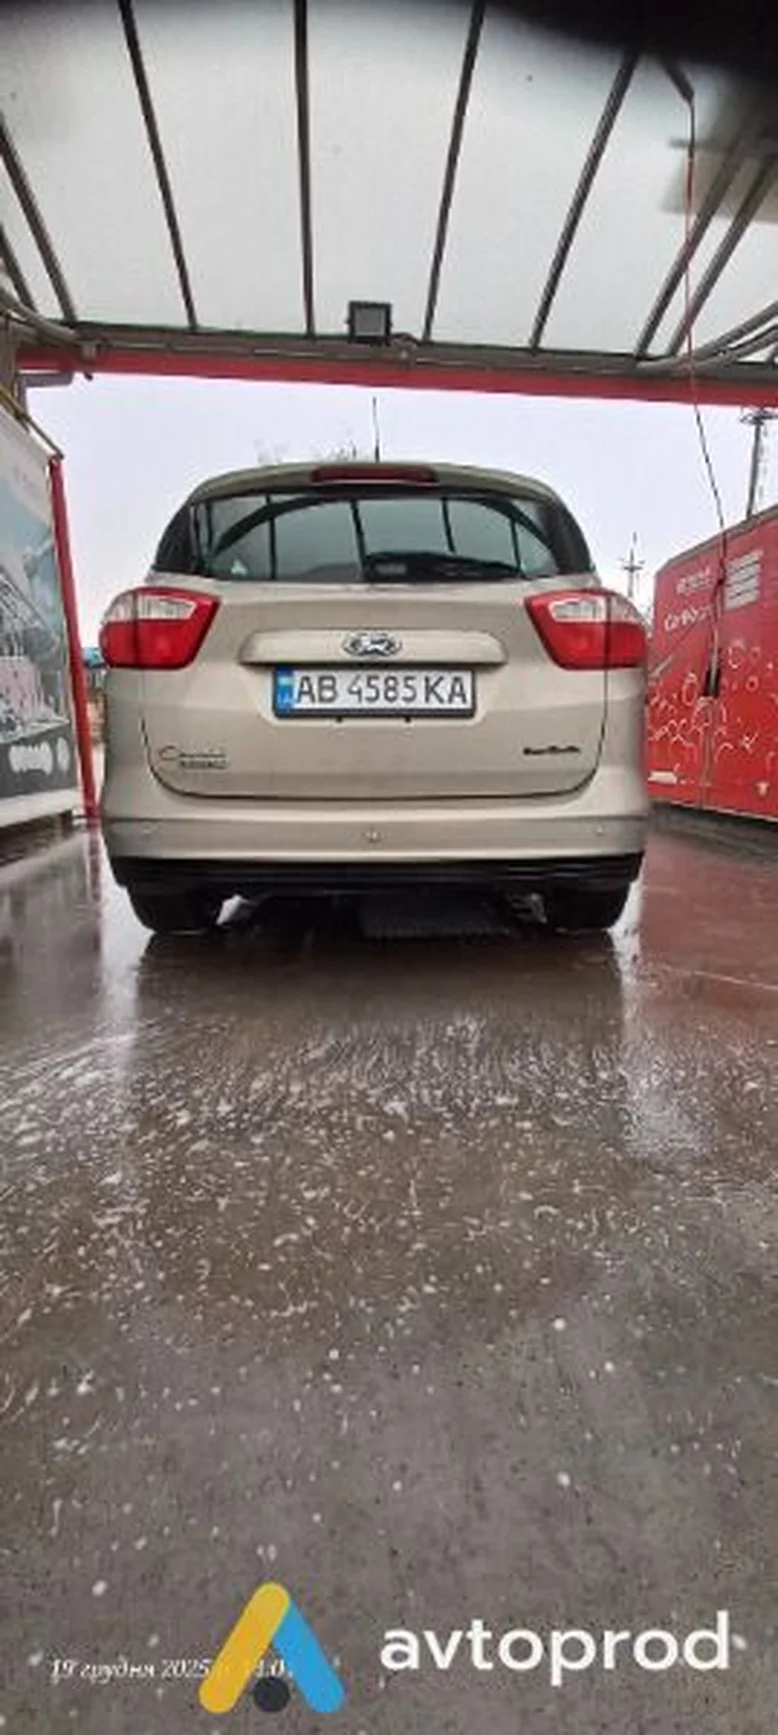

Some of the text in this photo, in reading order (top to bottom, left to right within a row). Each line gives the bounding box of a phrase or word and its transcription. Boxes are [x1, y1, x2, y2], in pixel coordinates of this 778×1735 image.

[297, 675, 338, 703] AB
[347, 675, 417, 703] 4585
[424, 675, 467, 703] KA
